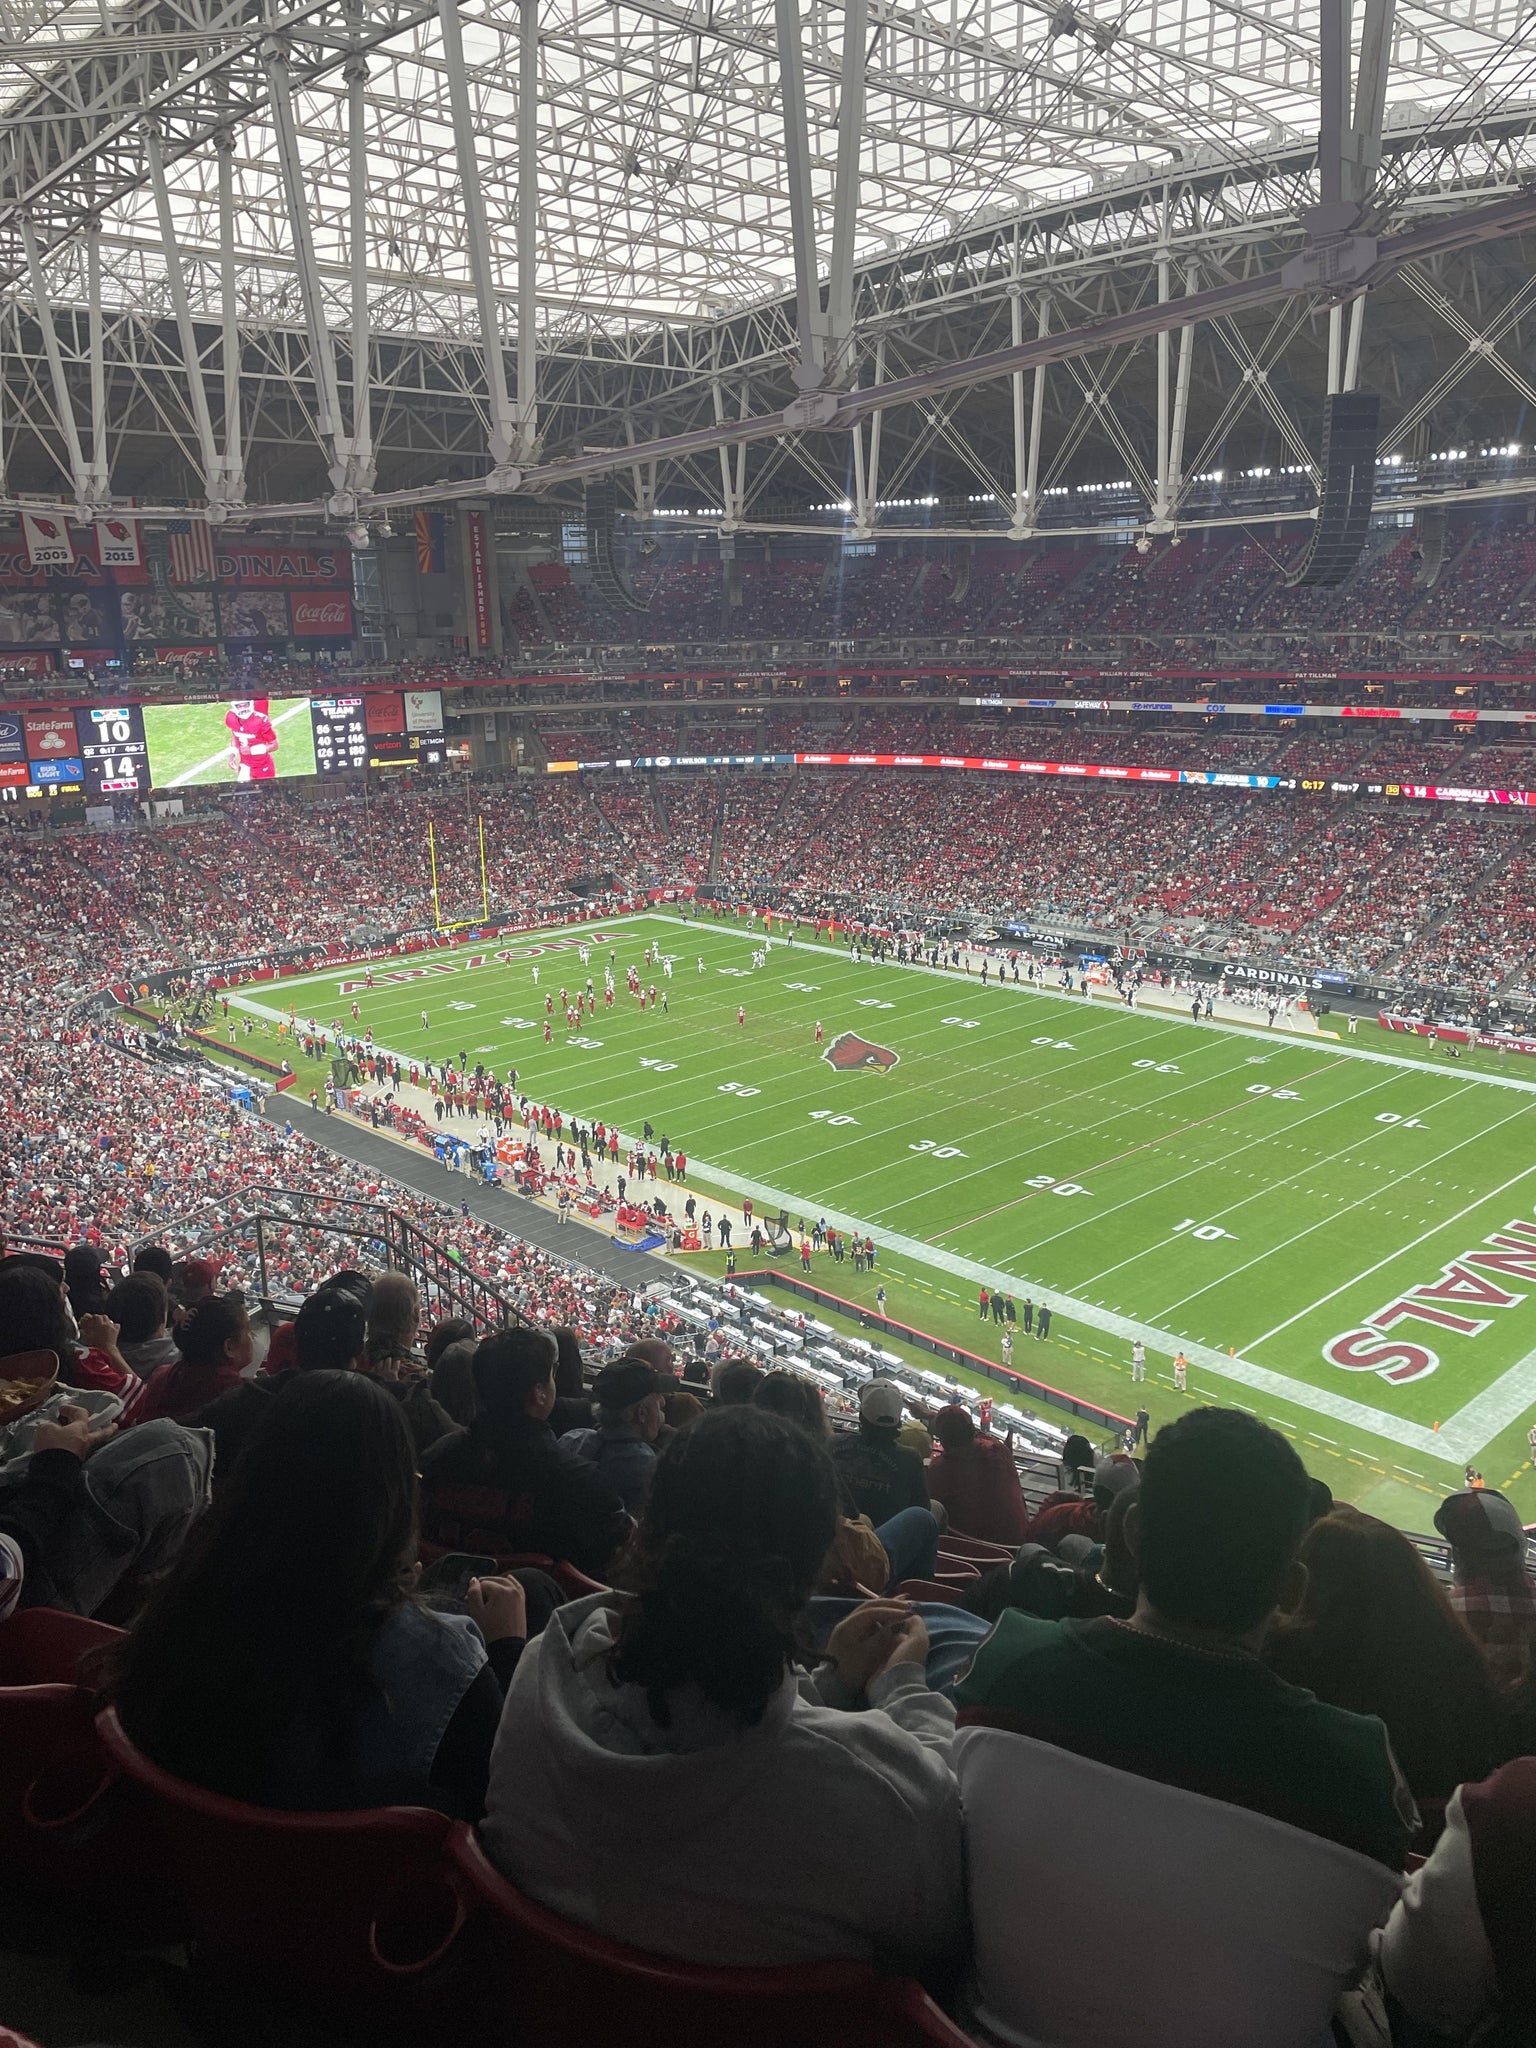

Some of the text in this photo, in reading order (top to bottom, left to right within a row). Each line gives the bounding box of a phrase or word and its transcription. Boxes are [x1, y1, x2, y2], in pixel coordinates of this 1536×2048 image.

[35, 551, 68, 561] 2009
[105, 552, 135, 561] 2015
[473, 526, 485, 612] ESTABLISHED
[295, 603, 346, 622] Coca-Cola
[321, 706, 354, 716] TEAM
[1075, 701, 1101, 709] SAFEWAY
[1206, 704, 1226, 712] COX
[99, 721, 130, 742] 10
[316, 724, 330, 734] 86
[349, 722, 361, 732] 34
[317, 736, 331, 746] 40
[348, 734, 365, 744] 146
[374, 741, 402, 750] verizon
[317, 748, 334, 758] 126
[427, 752, 439, 762] 30
[103, 757, 135, 778] 14
[323, 760, 330, 769] 5
[353, 757, 363, 767] 17
[1256, 776, 1268, 787] 10
[1301, 780, 1325, 790] 0:17
[1414, 787, 1489, 799] 14 CARDINALS
[333, 932, 640, 996] ARIZONA
[1224, 964, 1323, 989] CARDINALS
[940, 1016, 982, 1029] 50
[567, 1036, 604, 1050] 30
[640, 1057, 678, 1073] 40
[717, 1081, 762, 1098] 50
[1245, 1083, 1300, 1100] 20
[808, 1110, 856, 1126] 40
[1373, 1112, 1424, 1130] 10
[908, 1140, 961, 1159] 30
[1023, 1175, 1085, 1197] 20
[1172, 1218, 1227, 1241] 10
